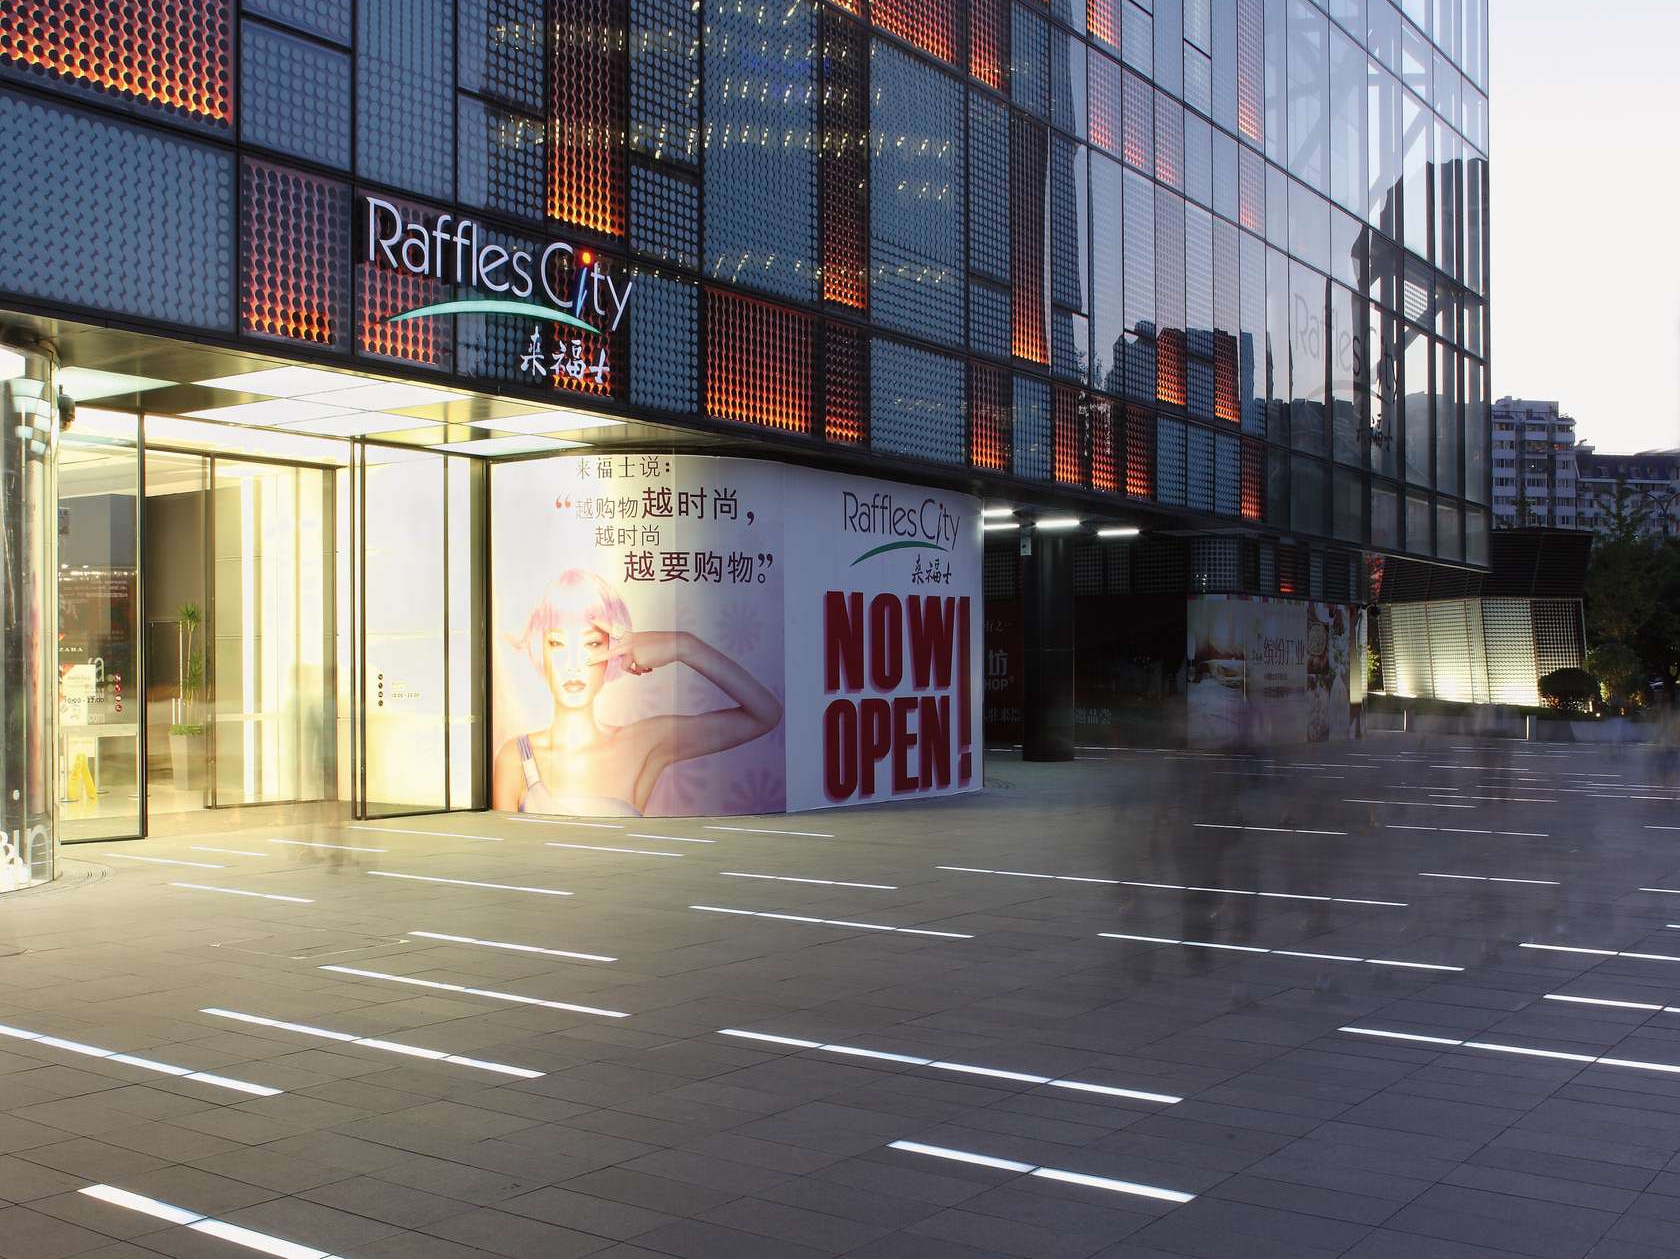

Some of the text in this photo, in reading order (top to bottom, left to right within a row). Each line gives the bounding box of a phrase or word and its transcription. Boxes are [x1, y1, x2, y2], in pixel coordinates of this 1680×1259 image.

[366, 196, 633, 332] Raffles City
[520, 325, 611, 384] 来福士
[594, 524, 661, 548] 越时尚
[842, 491, 960, 551] Raffles City
[912, 554, 952, 586] 来福士
[985, 678, 1009, 691] HOP
